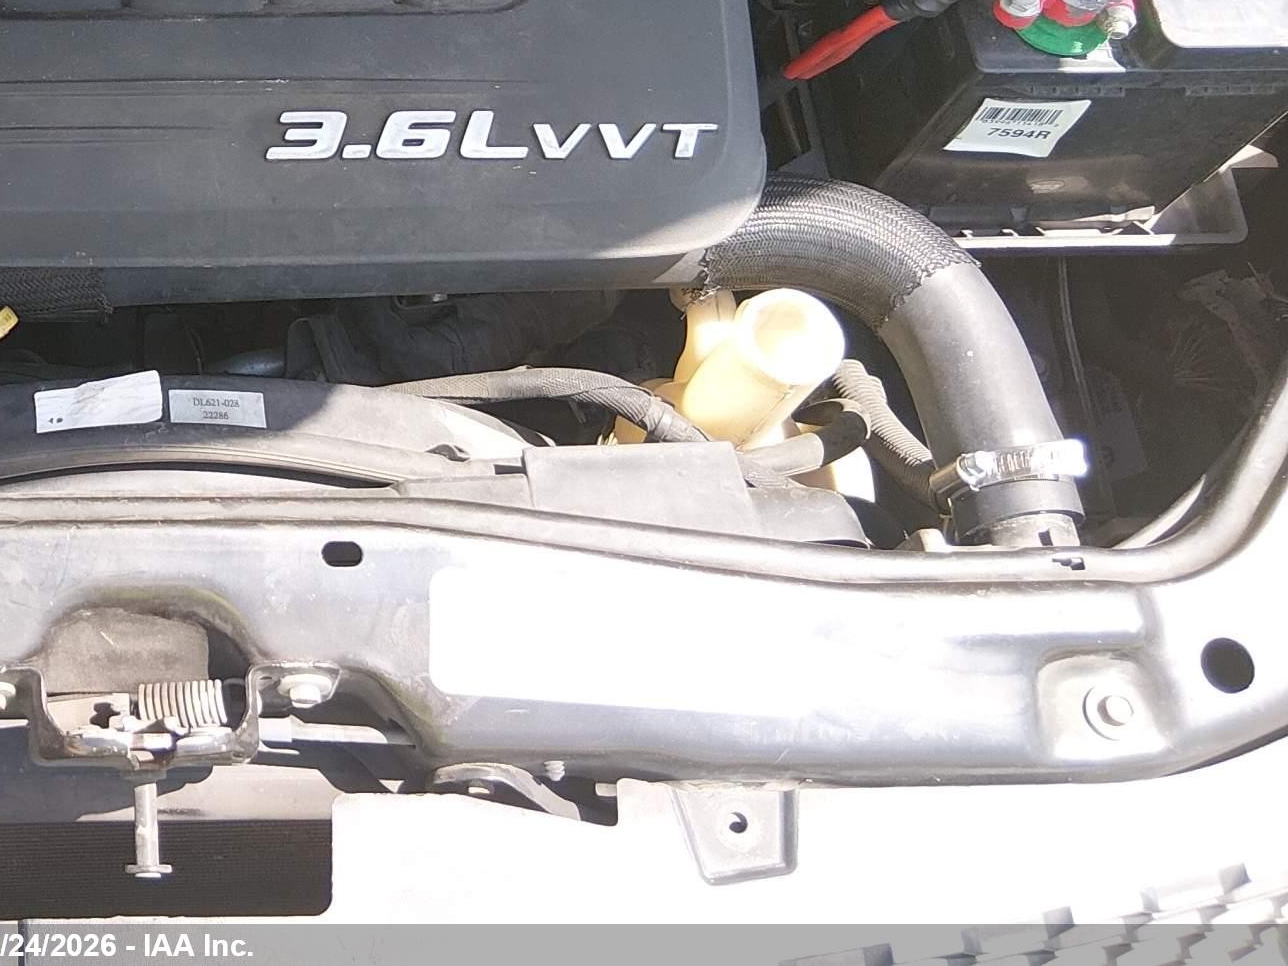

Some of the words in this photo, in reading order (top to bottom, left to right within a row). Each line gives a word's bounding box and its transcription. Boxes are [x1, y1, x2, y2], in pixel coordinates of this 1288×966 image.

[264, 110, 529, 161] 3.6L
[530, 122, 720, 161] VVT
[987, 127, 1051, 139] 7594R
